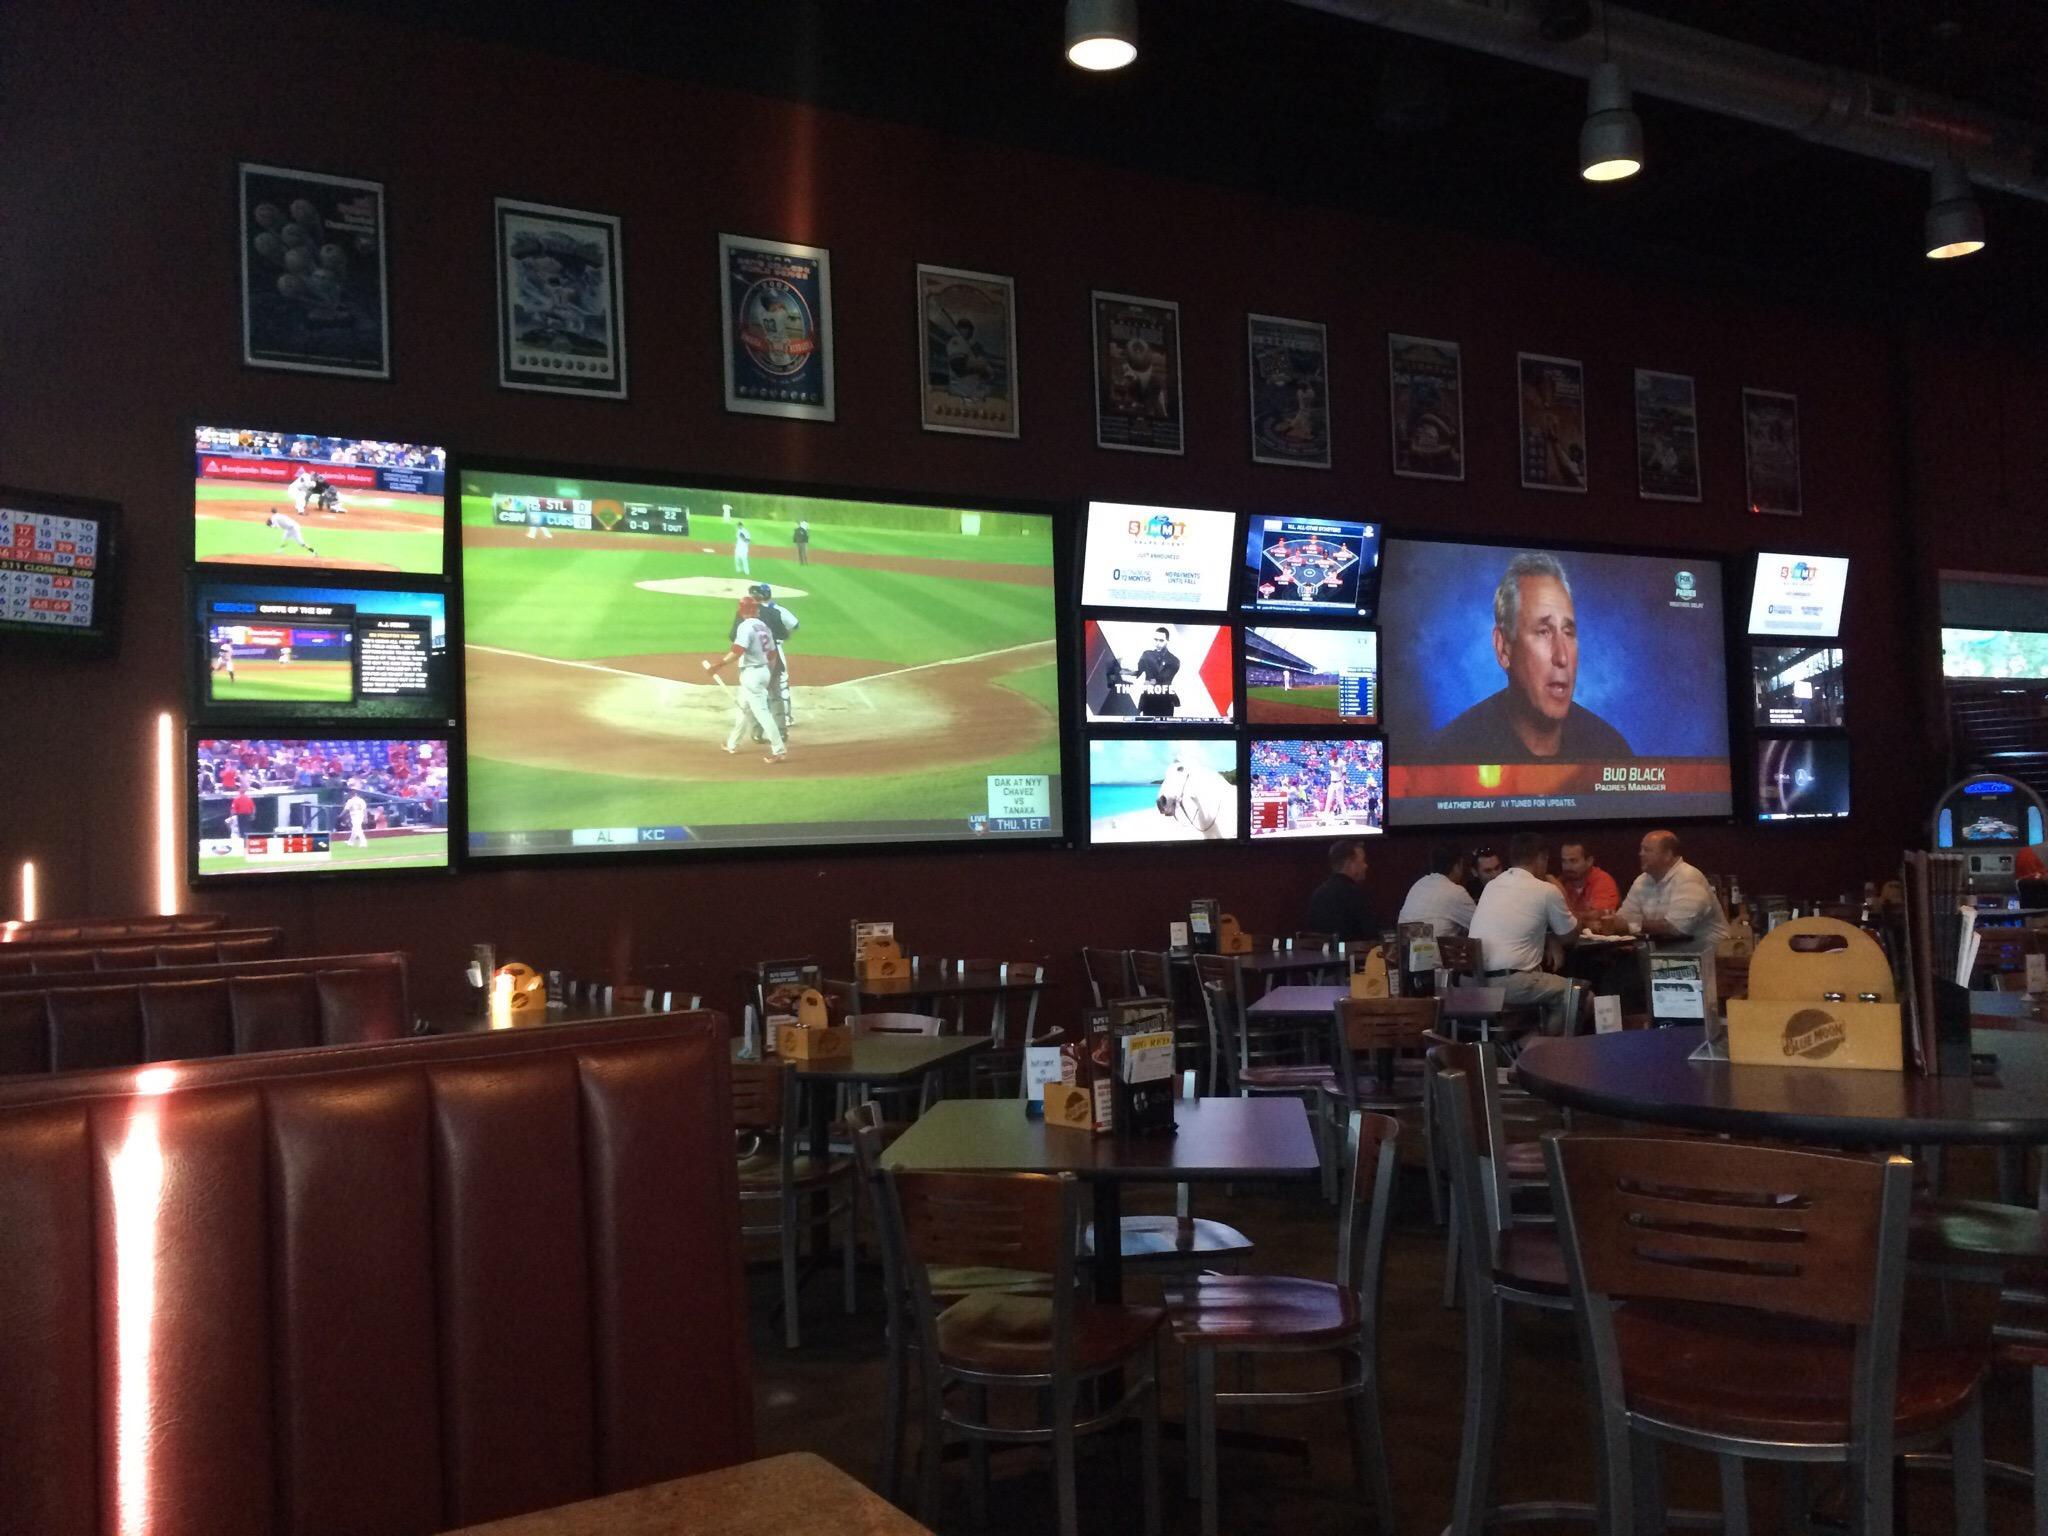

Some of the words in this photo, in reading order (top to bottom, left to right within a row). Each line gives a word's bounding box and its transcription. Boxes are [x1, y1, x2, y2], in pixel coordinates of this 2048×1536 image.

[546, 500, 567, 511] STL
[546, 513, 574, 526] CUBS
[664, 511, 677, 520] 22
[1, 511, 8, 520] 6
[22, 514, 29, 522] 7
[43, 517, 50, 526] 8
[63, 520, 70, 528] 9
[80, 522, 94, 532] 10
[629, 520, 650, 530] 0-0
[20, 527, 31, 535] 17
[40, 529, 52, 538] 18
[60, 532, 72, 540] 19
[79, 534, 94, 542] 20
[38, 541, 52, 549] 28
[58, 543, 73, 552] 29
[78, 546, 93, 554] 30
[16, 550, 31, 558] 37
[58, 555, 71, 564] 39
[76, 557, 92, 567] 40
[24, 563, 69, 574] CLOSING
[14, 574, 29, 582] 47
[36, 577, 50, 585] 48
[14, 586, 27, 594] 57
[35, 588, 48, 597] 58
[55, 590, 69, 599] 59
[74, 592, 90, 600] 60
[32, 600, 49, 608] 68
[53, 601, 70, 610] 69
[74, 603, 88, 612] 70
[287, 606, 299, 614] OF
[300, 606, 315, 615] THE
[316, 607, 333, 615] DAY
[33, 612, 47, 620] 78
[54, 613, 67, 621] 79
[1603, 767, 1627, 781] BUD
[1629, 767, 1666, 781] BLACK
[1013, 778, 1023, 786] AT
[1025, 778, 1043, 787] NYY
[1594, 783, 1626, 791] PADRES
[1628, 783, 1666, 791] MANAGER
[1003, 787, 1034, 796] CHAVEZ
[1014, 797, 1025, 805] VS
[1437, 800, 1471, 809] WEATHER
[1473, 800, 1496, 809] DELAY
[1533, 799, 1545, 807] FOR
[1003, 806, 1035, 814] TANAKA
[997, 819, 1020, 829] THU.
[1030, 818, 1044, 829] ET
[596, 831, 615, 842] AL
[642, 829, 666, 840] KC
